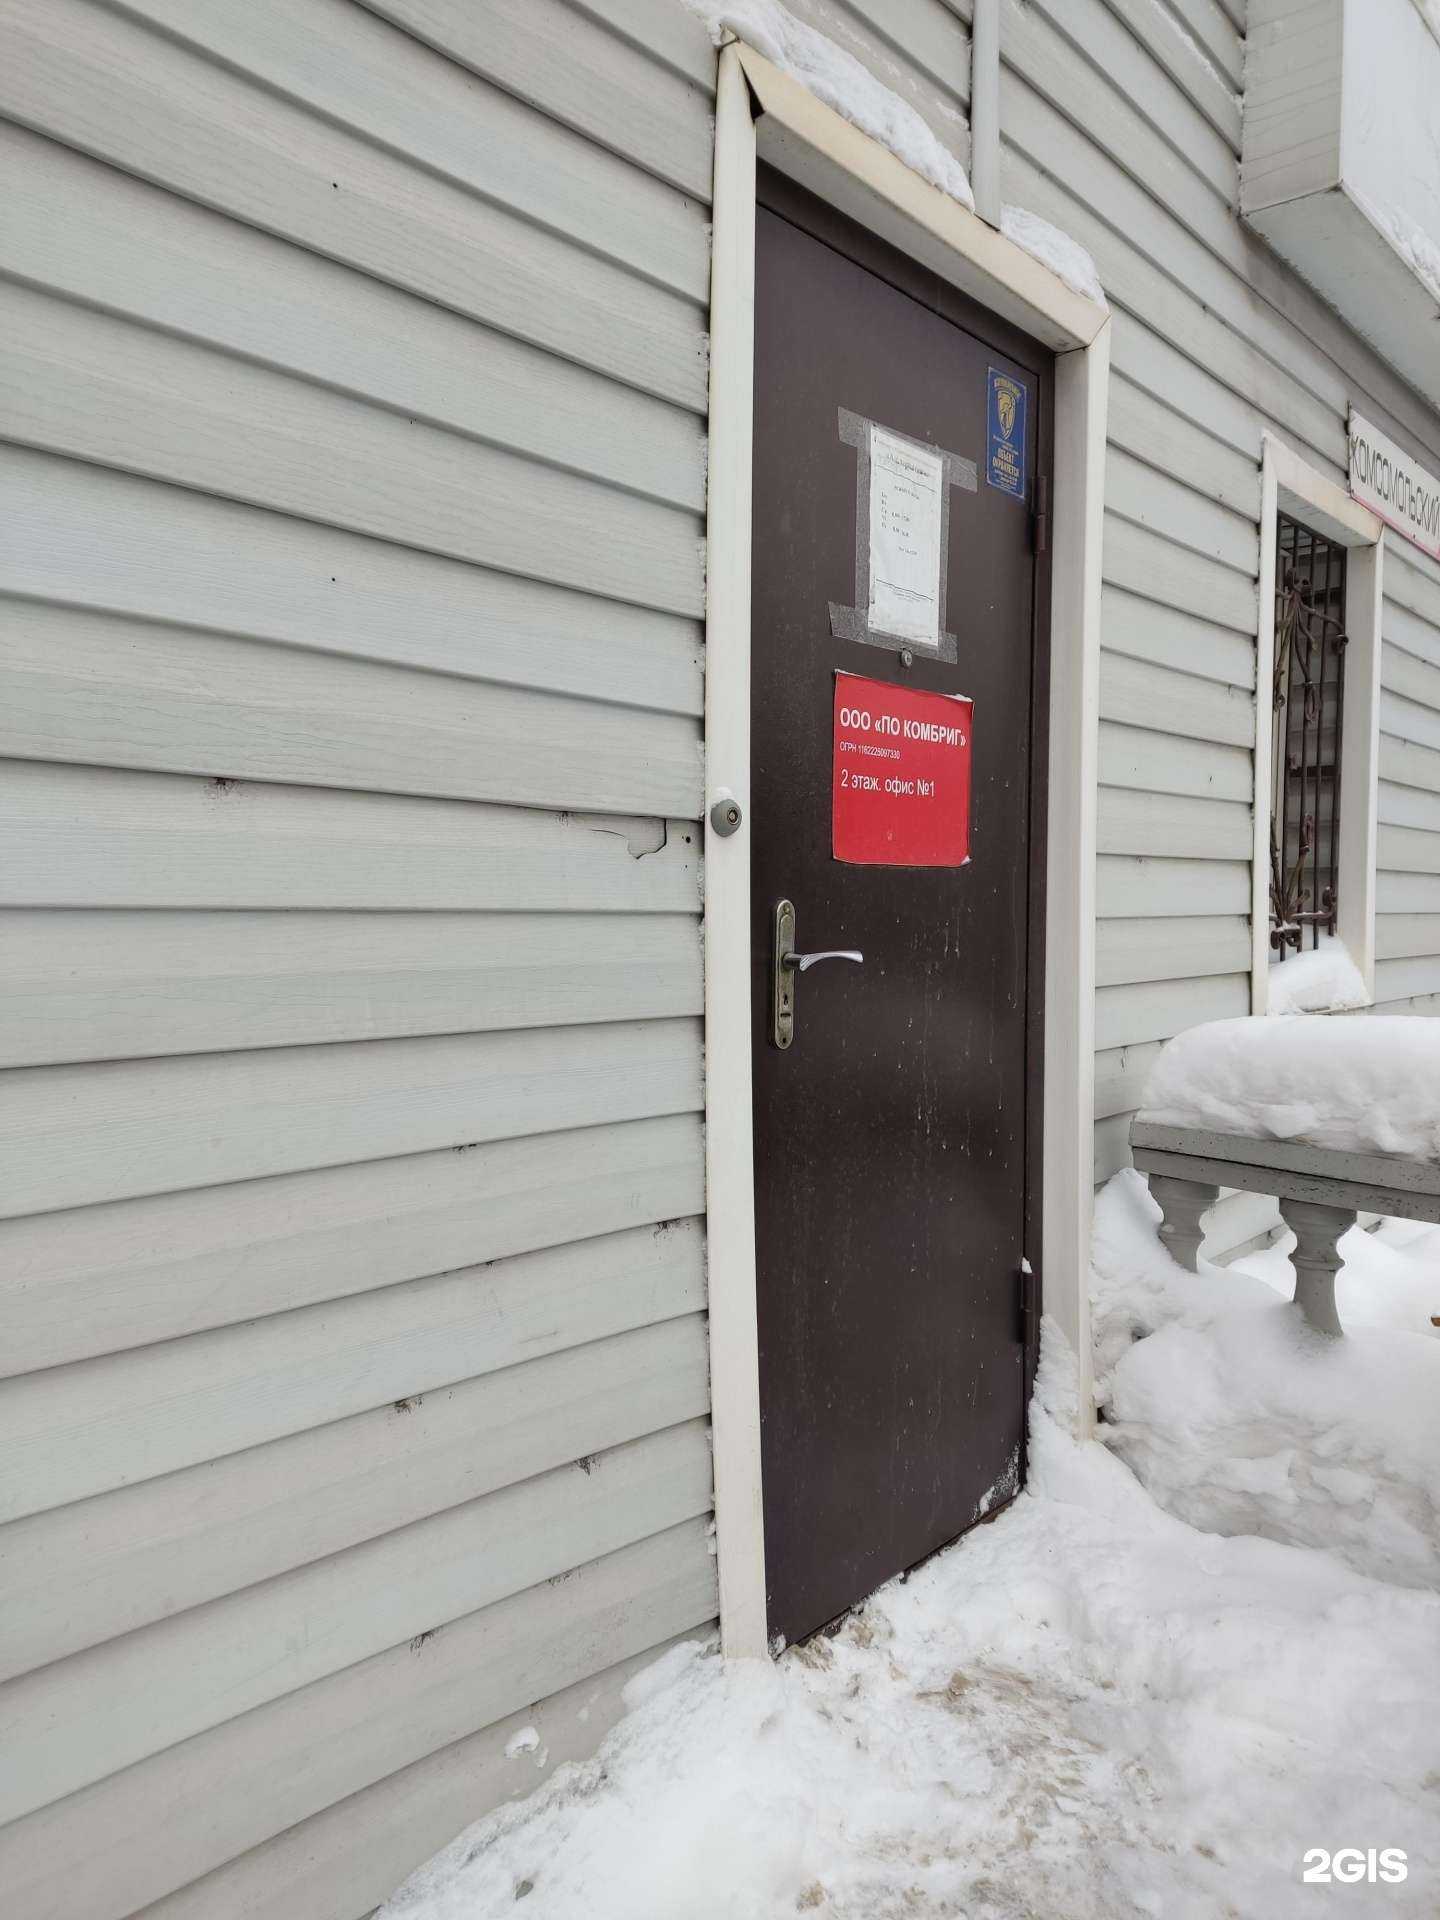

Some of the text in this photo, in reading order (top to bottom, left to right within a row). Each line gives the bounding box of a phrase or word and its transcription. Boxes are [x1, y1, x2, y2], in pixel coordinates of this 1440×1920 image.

[1351, 432, 1440, 539] КОМСОМОЛЬСКИЙ
[840, 708, 966, 746] ООО «ПО КОМБРИГ»
[840, 741, 857, 752] ОГРН
[841, 769, 935, 798] 2 этаж. офис №1
